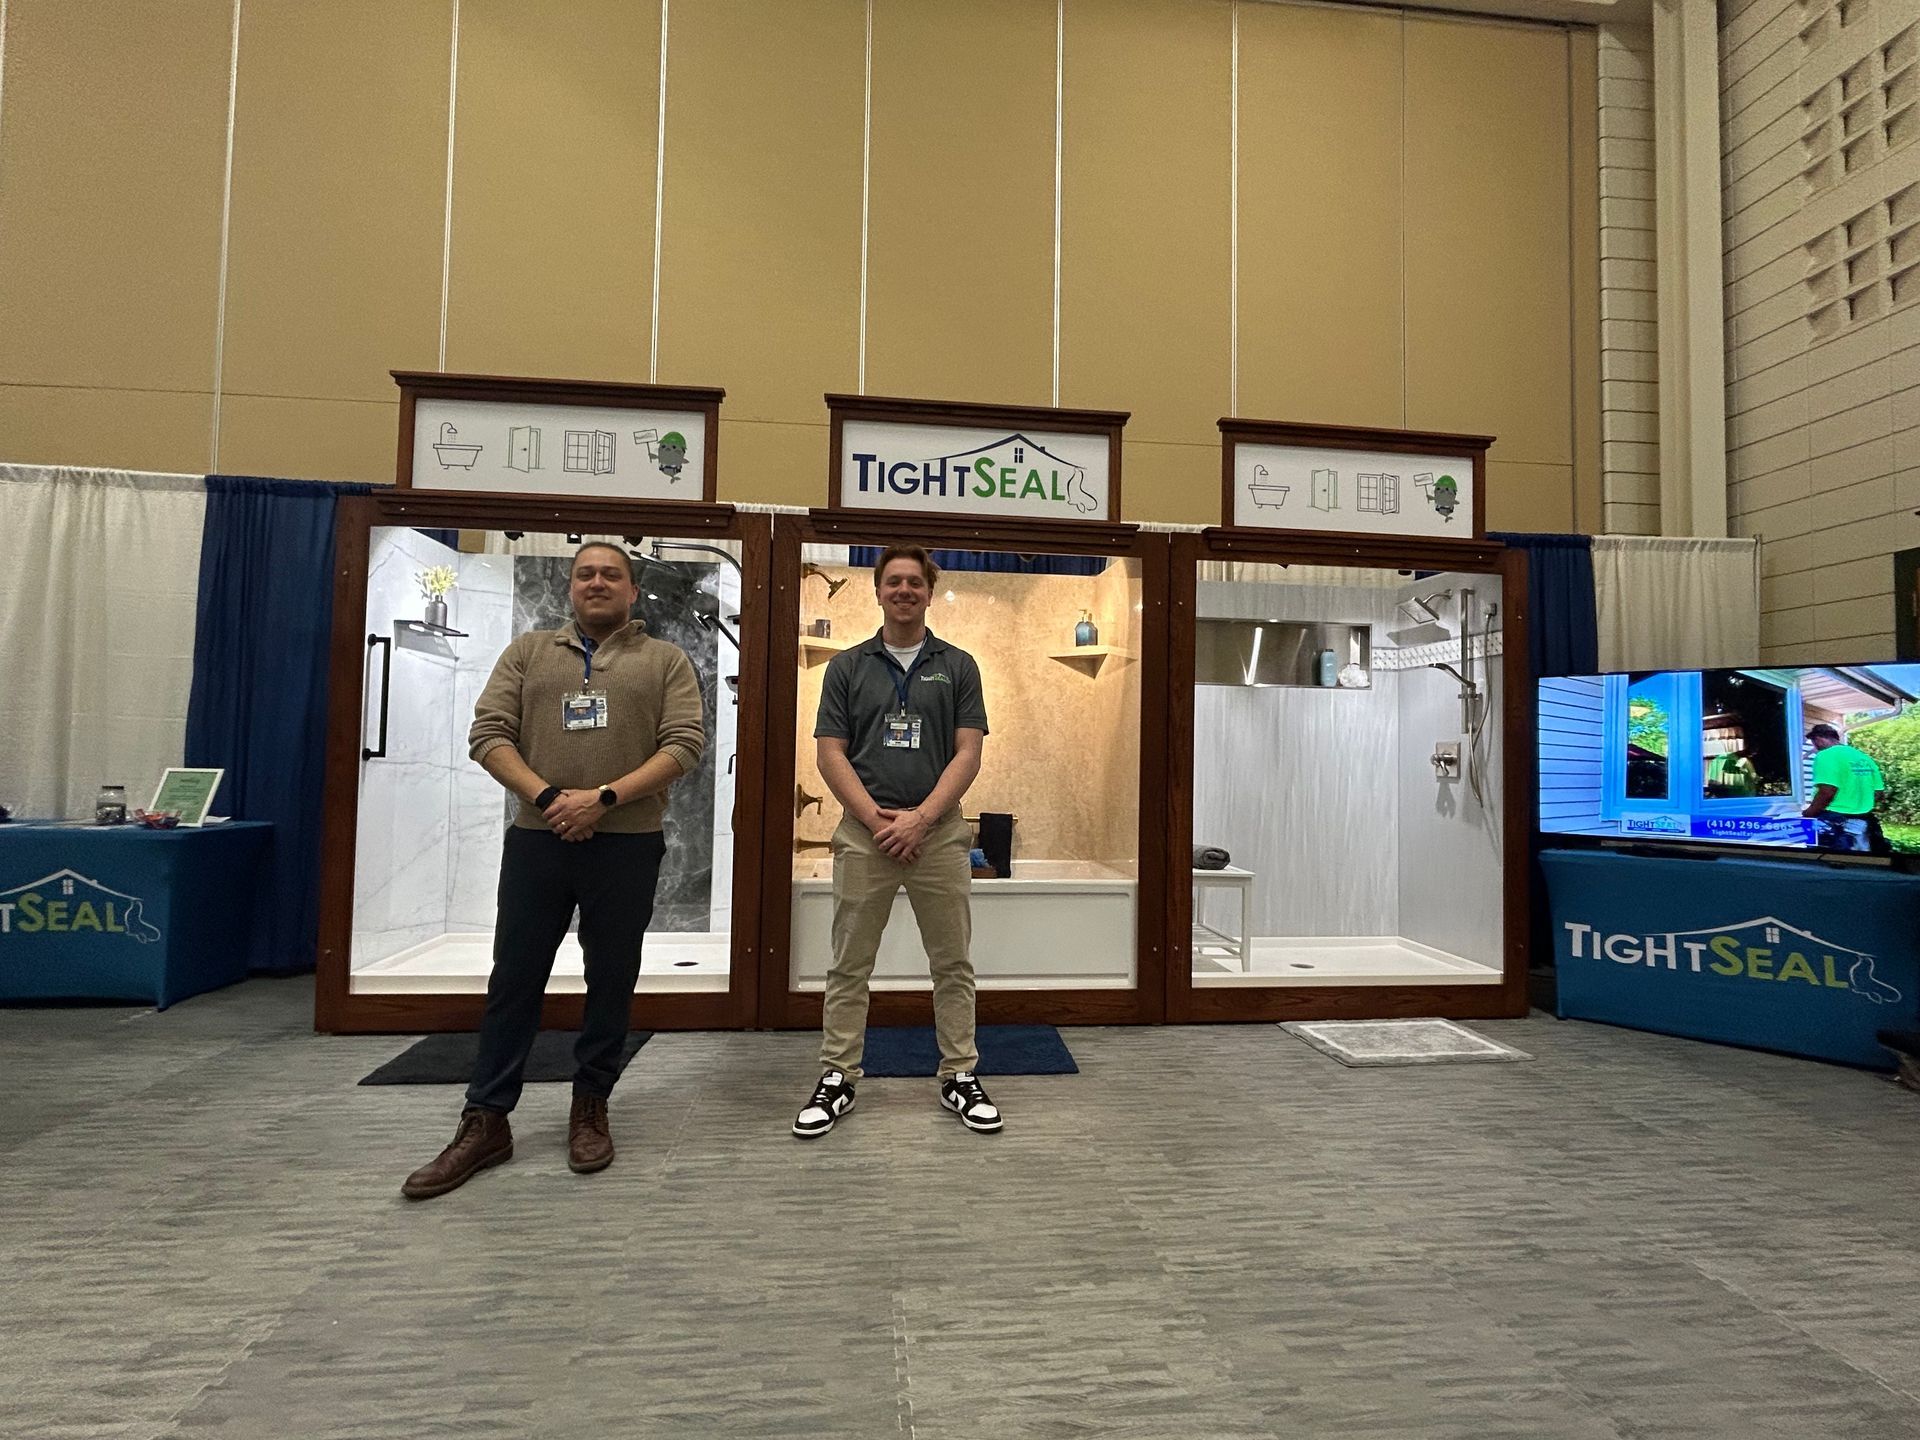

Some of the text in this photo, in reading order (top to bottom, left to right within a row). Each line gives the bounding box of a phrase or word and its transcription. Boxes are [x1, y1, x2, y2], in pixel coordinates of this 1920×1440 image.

[852, 453, 1066, 501] TIGHTSEAL
[1706, 819, 1736, 830] (414)
[1564, 921, 1849, 989] TIGHTSEAL
